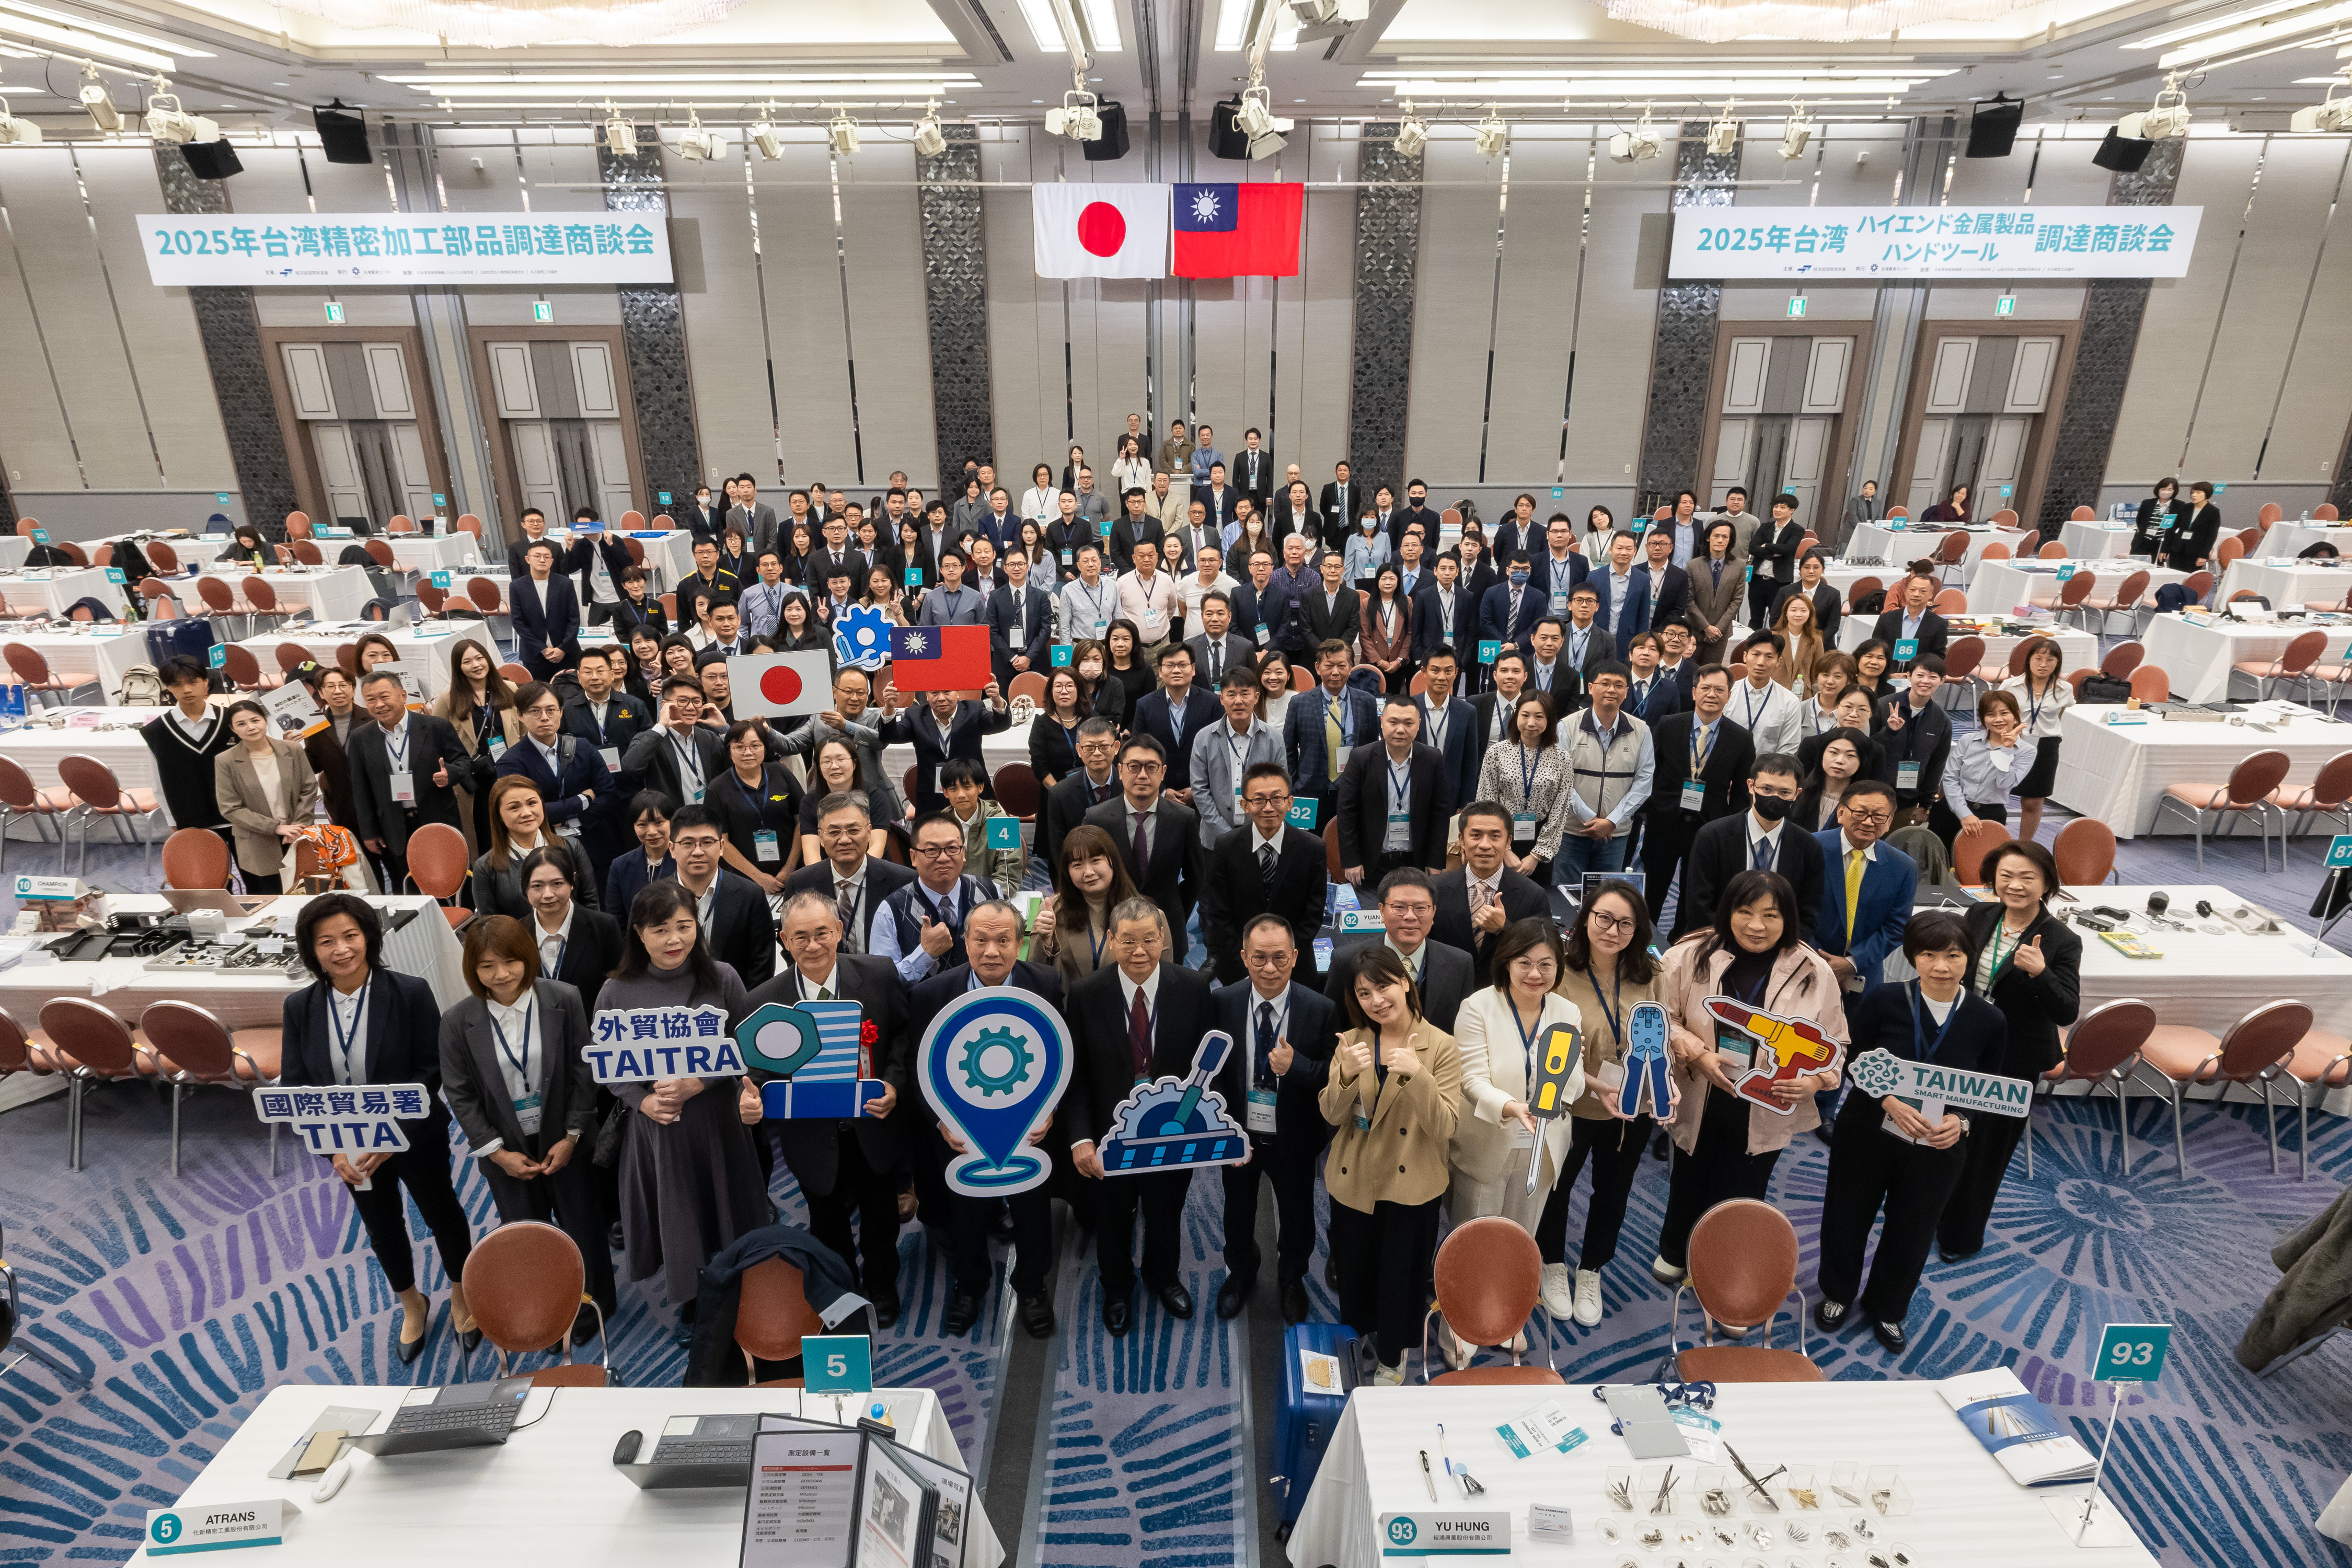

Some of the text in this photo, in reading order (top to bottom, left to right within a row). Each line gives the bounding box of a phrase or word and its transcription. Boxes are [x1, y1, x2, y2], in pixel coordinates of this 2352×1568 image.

[1857, 213, 2035, 235] ハイエンド金属製品
[156, 224, 654, 257] 2025年台湾精密加工部品調達商談会
[1697, 225, 1848, 253] 2025年台湾
[2034, 224, 2175, 252] 調達商談会
[1882, 243, 1999, 262] ハンドツール
[213, 650, 223, 661] 15
[1059, 651, 1066, 661] 3
[1483, 647, 1495, 656] 91
[1898, 646, 1913, 654] 86
[1290, 807, 1311, 820] 92
[999, 827, 1009, 840] 4
[19, 880, 30, 890] 10
[1346, 916, 1357, 925] 92
[597, 1011, 722, 1042] 外貿協會
[587, 1044, 742, 1078] TAITRA
[1912, 1067, 2028, 1105] TAIWAN
[261, 1089, 423, 1119] 國際貿易署
[1914, 1089, 2024, 1114] SMART MANUFACTURING
[299, 1122, 402, 1149] TITA
[2111, 1342, 2153, 1365] 93
[827, 1354, 847, 1377] 5
[942, 1478, 965, 1494] 現場写真
[205, 1511, 255, 1525] ATRANS
[1435, 1522, 1490, 1531] YU HUNG
[160, 1520, 172, 1538] 5
[193, 1523, 268, 1536] 化新精密工業股份有限公司
[1391, 1523, 1413, 1540] 93
